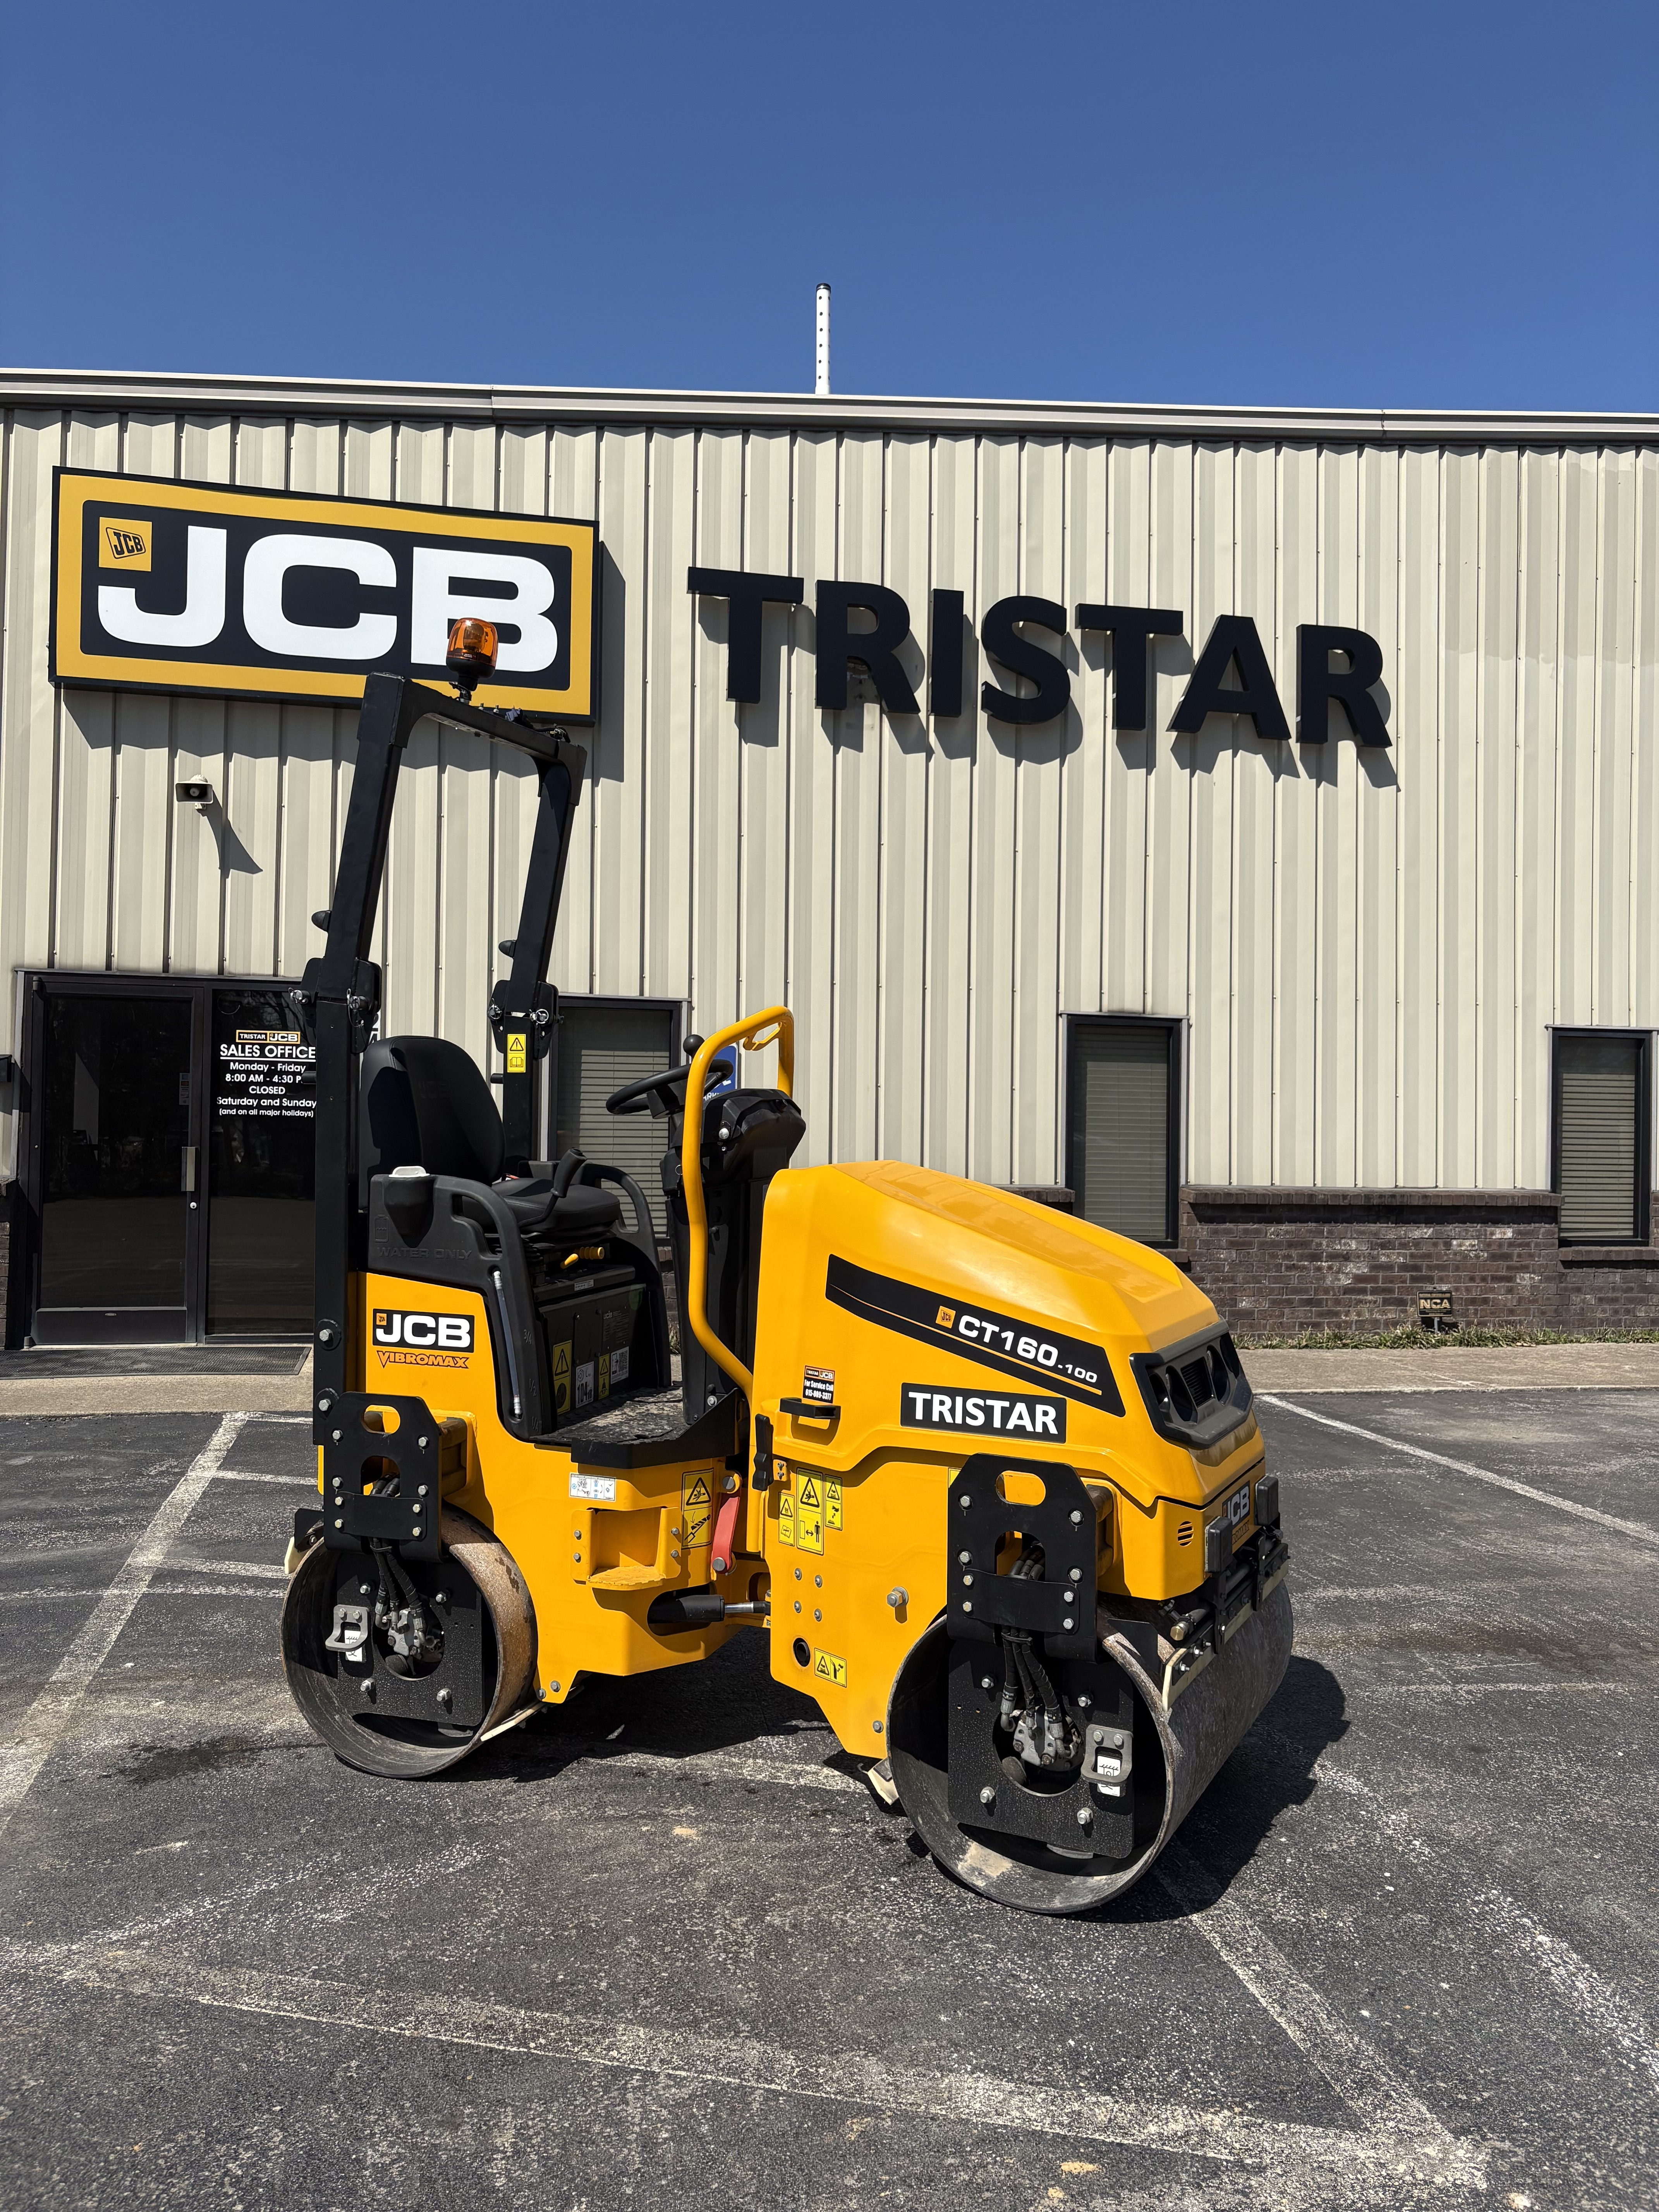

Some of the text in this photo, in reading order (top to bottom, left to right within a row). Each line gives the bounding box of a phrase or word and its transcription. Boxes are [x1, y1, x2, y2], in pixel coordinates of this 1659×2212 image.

[113, 531, 143, 555] JCB
[98, 526, 558, 672] JCB
[687, 567, 1393, 749] TRISTAR
[270, 1033, 298, 1041] JCB
[220, 1044, 316, 1058] SALES OFFICE
[230, 1062, 269, 1072] Monday
[278, 1063, 306, 1073] Friday
[249, 1086, 285, 1094] CLOSED
[216, 1097, 258, 1107] Saturday
[282, 1099, 317, 1108] Sunday
[282, 1109, 314, 1118] holidays)
[377, 1247, 472, 1260] WATER ONLY
[1420, 1299, 1451, 1309] NCA
[376, 1314, 471, 1348] JCB
[524, 1329, 532, 1345] 3/4
[376, 1350, 469, 1369] VIBROMAX
[820, 1371, 833, 1379] JCB
[811, 1381, 826, 1389] Service
[908, 1392, 1058, 1434] TRISTAR
